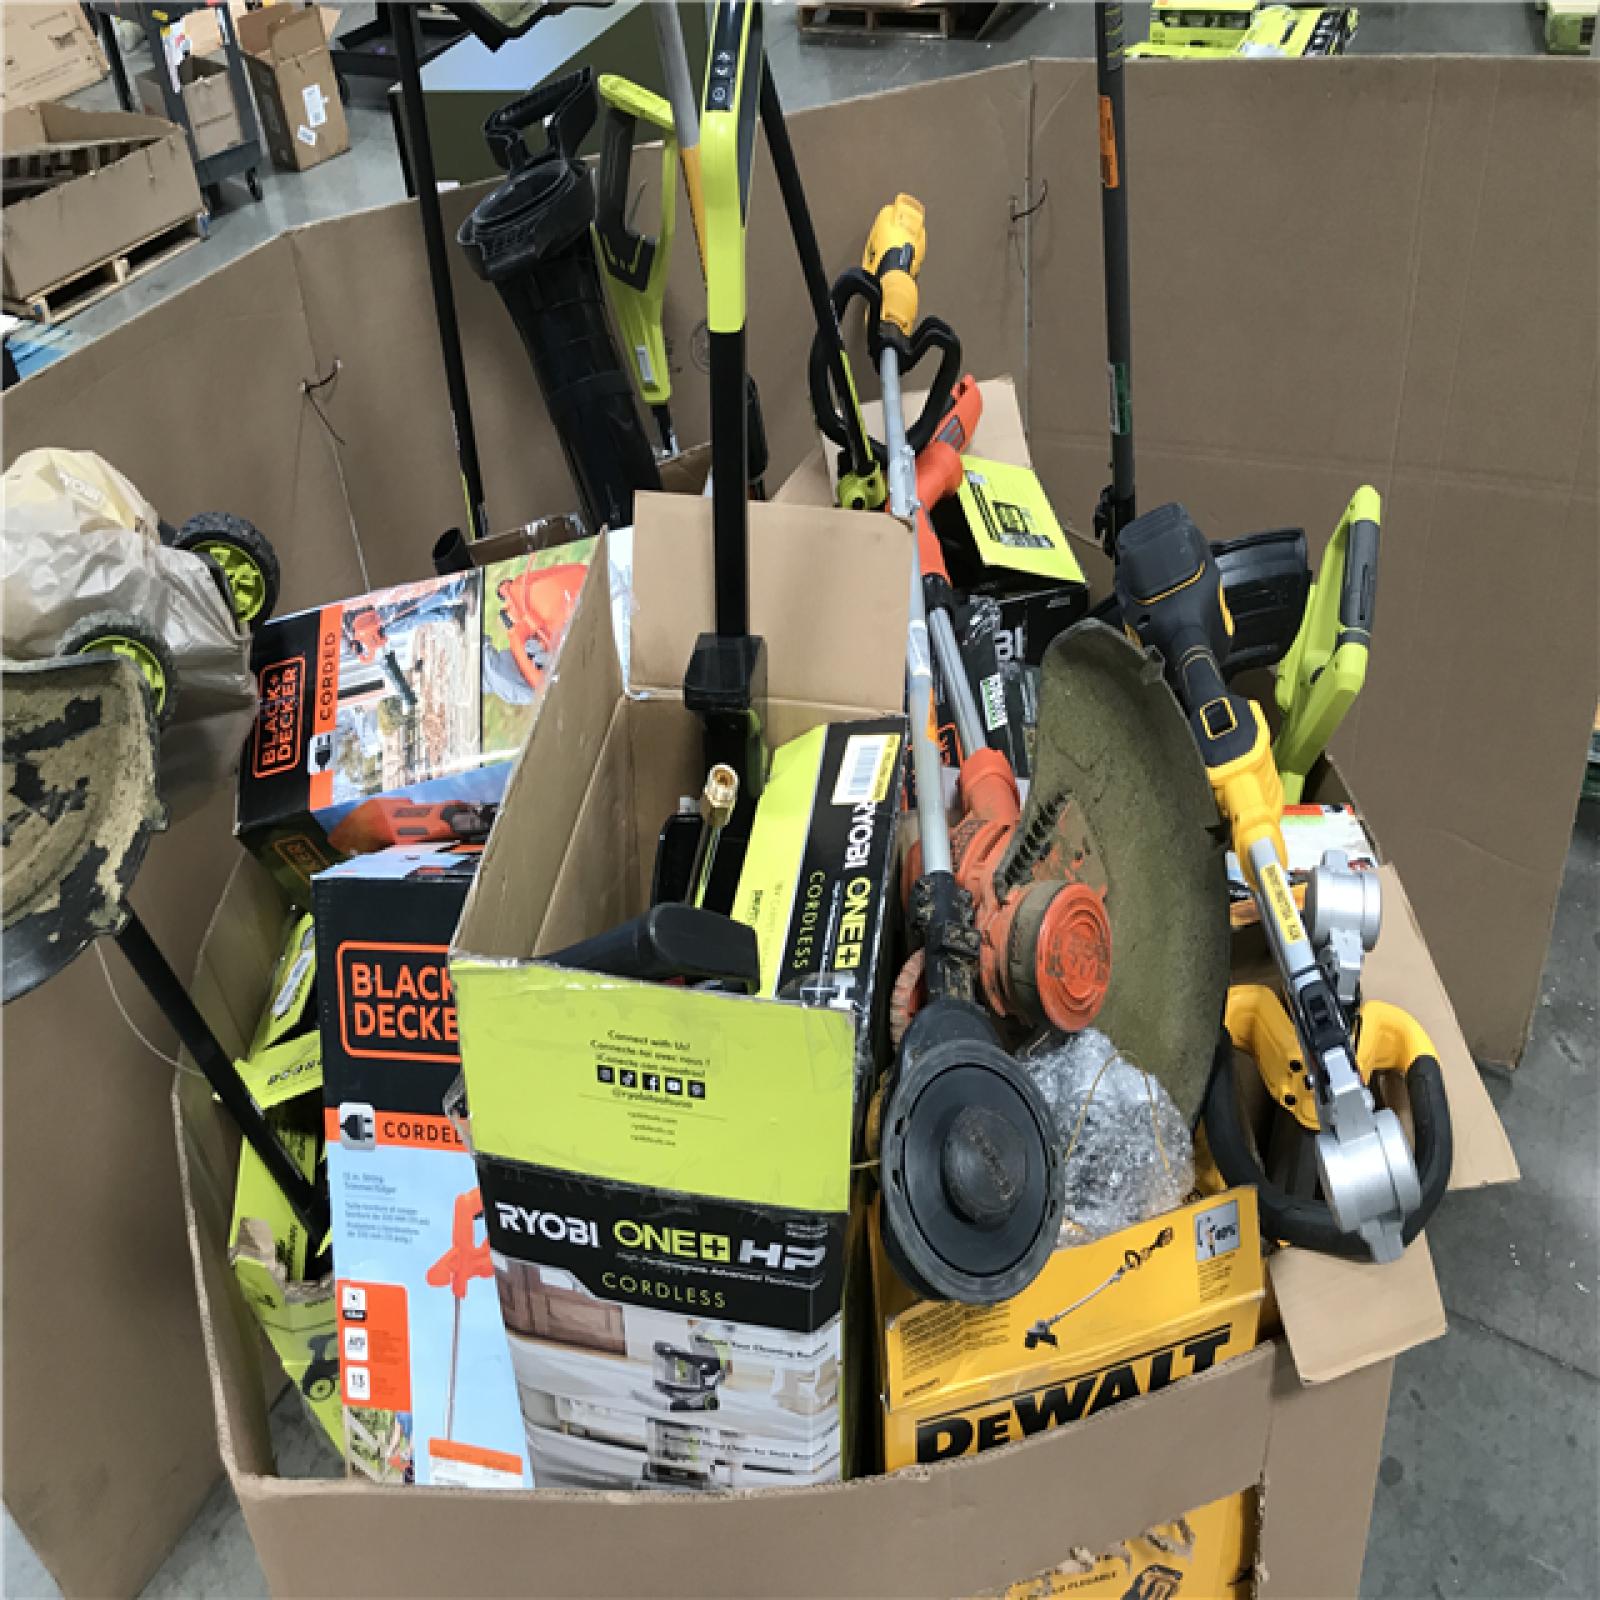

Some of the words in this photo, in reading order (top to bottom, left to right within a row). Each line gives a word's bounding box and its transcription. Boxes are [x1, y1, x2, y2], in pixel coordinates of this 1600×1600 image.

[277, 665, 298, 763] DECKER
[320, 631, 337, 721] CORDED
[791, 870, 826, 969] CORDLESS
[494, 1200, 600, 1249] RYOBI
[738, 1238, 828, 1271] HP
[601, 1271, 726, 1309] CORDLESS
